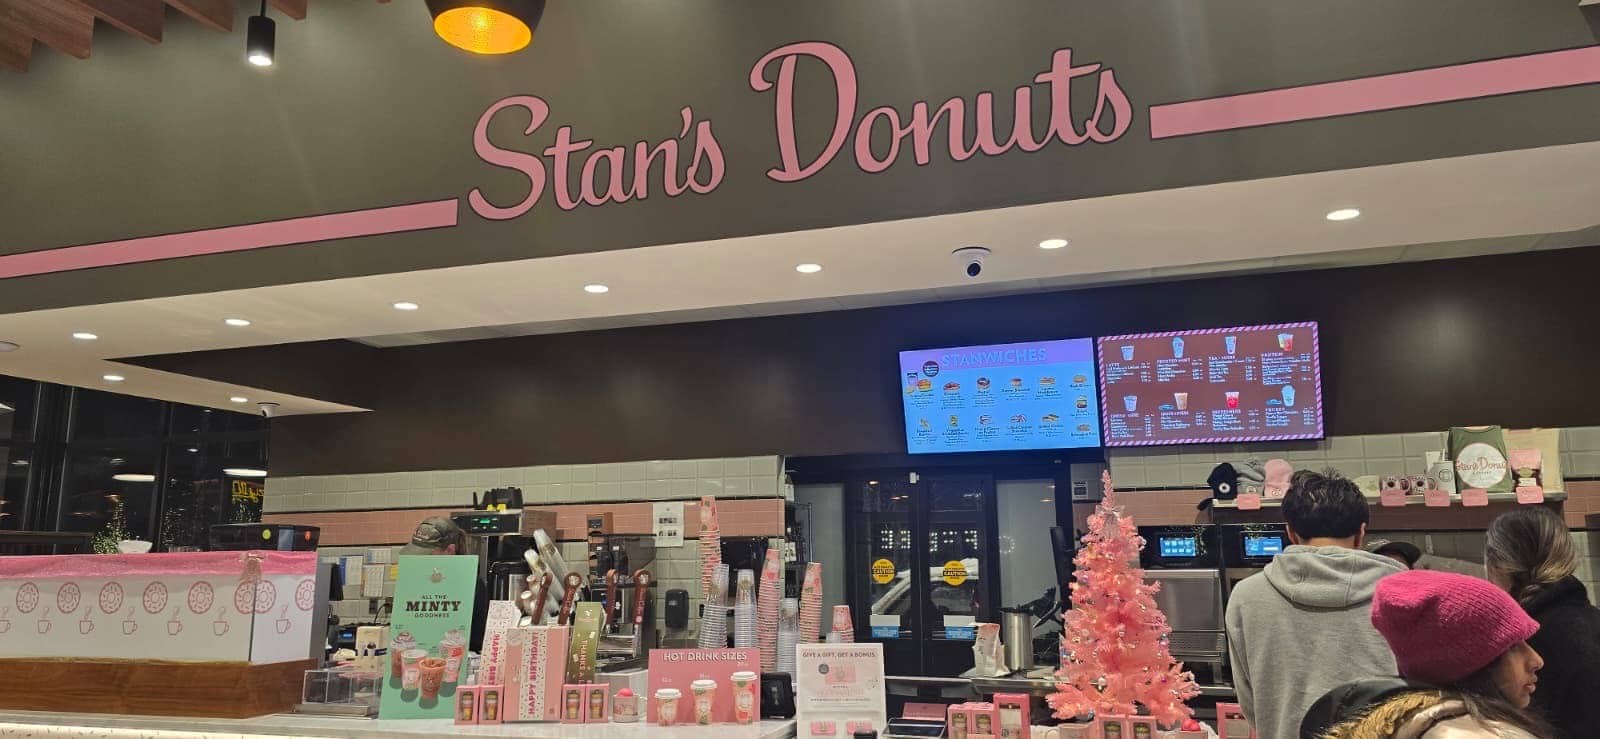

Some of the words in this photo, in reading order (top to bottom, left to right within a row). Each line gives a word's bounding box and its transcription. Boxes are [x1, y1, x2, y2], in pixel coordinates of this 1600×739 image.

[468, 95, 726, 221] Stan's
[748, 41, 1133, 183] Donuts
[942, 348, 1047, 368] STANWICHES
[406, 601, 461, 611] MINTY
[490, 633, 500, 663] HAPPY
[530, 632, 539, 681] BIRTHDAY!
[579, 640, 588, 671] THANKS
[663, 652, 683, 661] HOT
[687, 652, 719, 661] DRINK
[721, 651, 747, 660] SIZES
[528, 683, 537, 715] HAPPY
